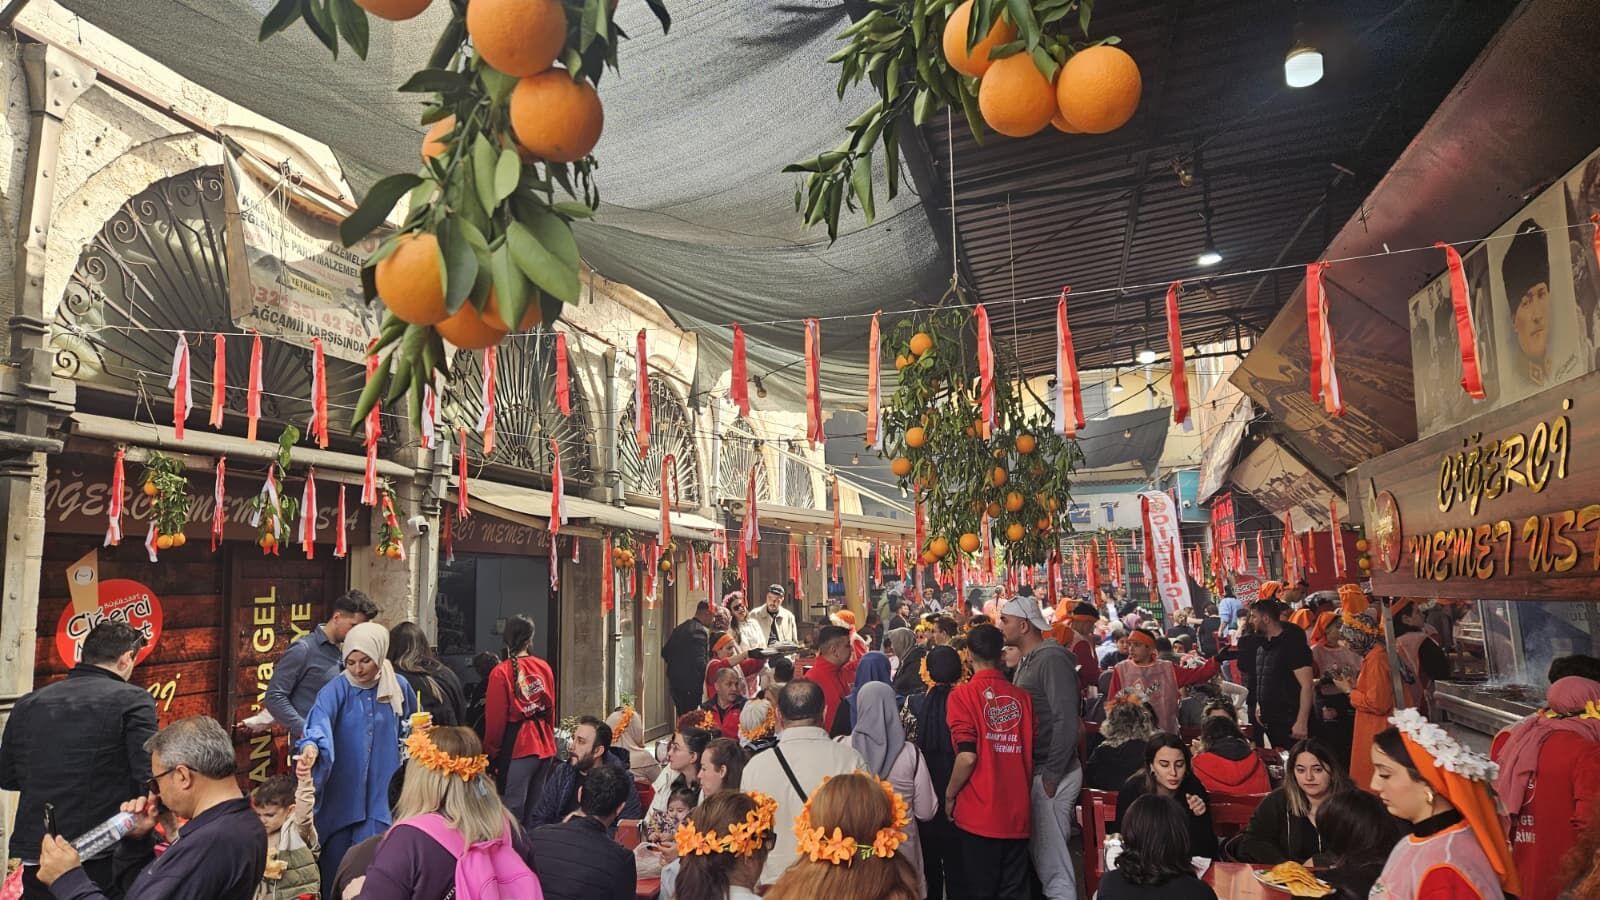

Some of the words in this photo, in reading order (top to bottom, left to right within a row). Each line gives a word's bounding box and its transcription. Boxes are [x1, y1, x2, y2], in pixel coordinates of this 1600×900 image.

[316, 254, 361, 278] MALZEMEL
[323, 312, 342, 331] 42
[482, 521, 533, 545] MEMET
[1408, 520, 1513, 582] MEMET
[1523, 504, 1600, 574] UST
[252, 586, 276, 653] GEL
